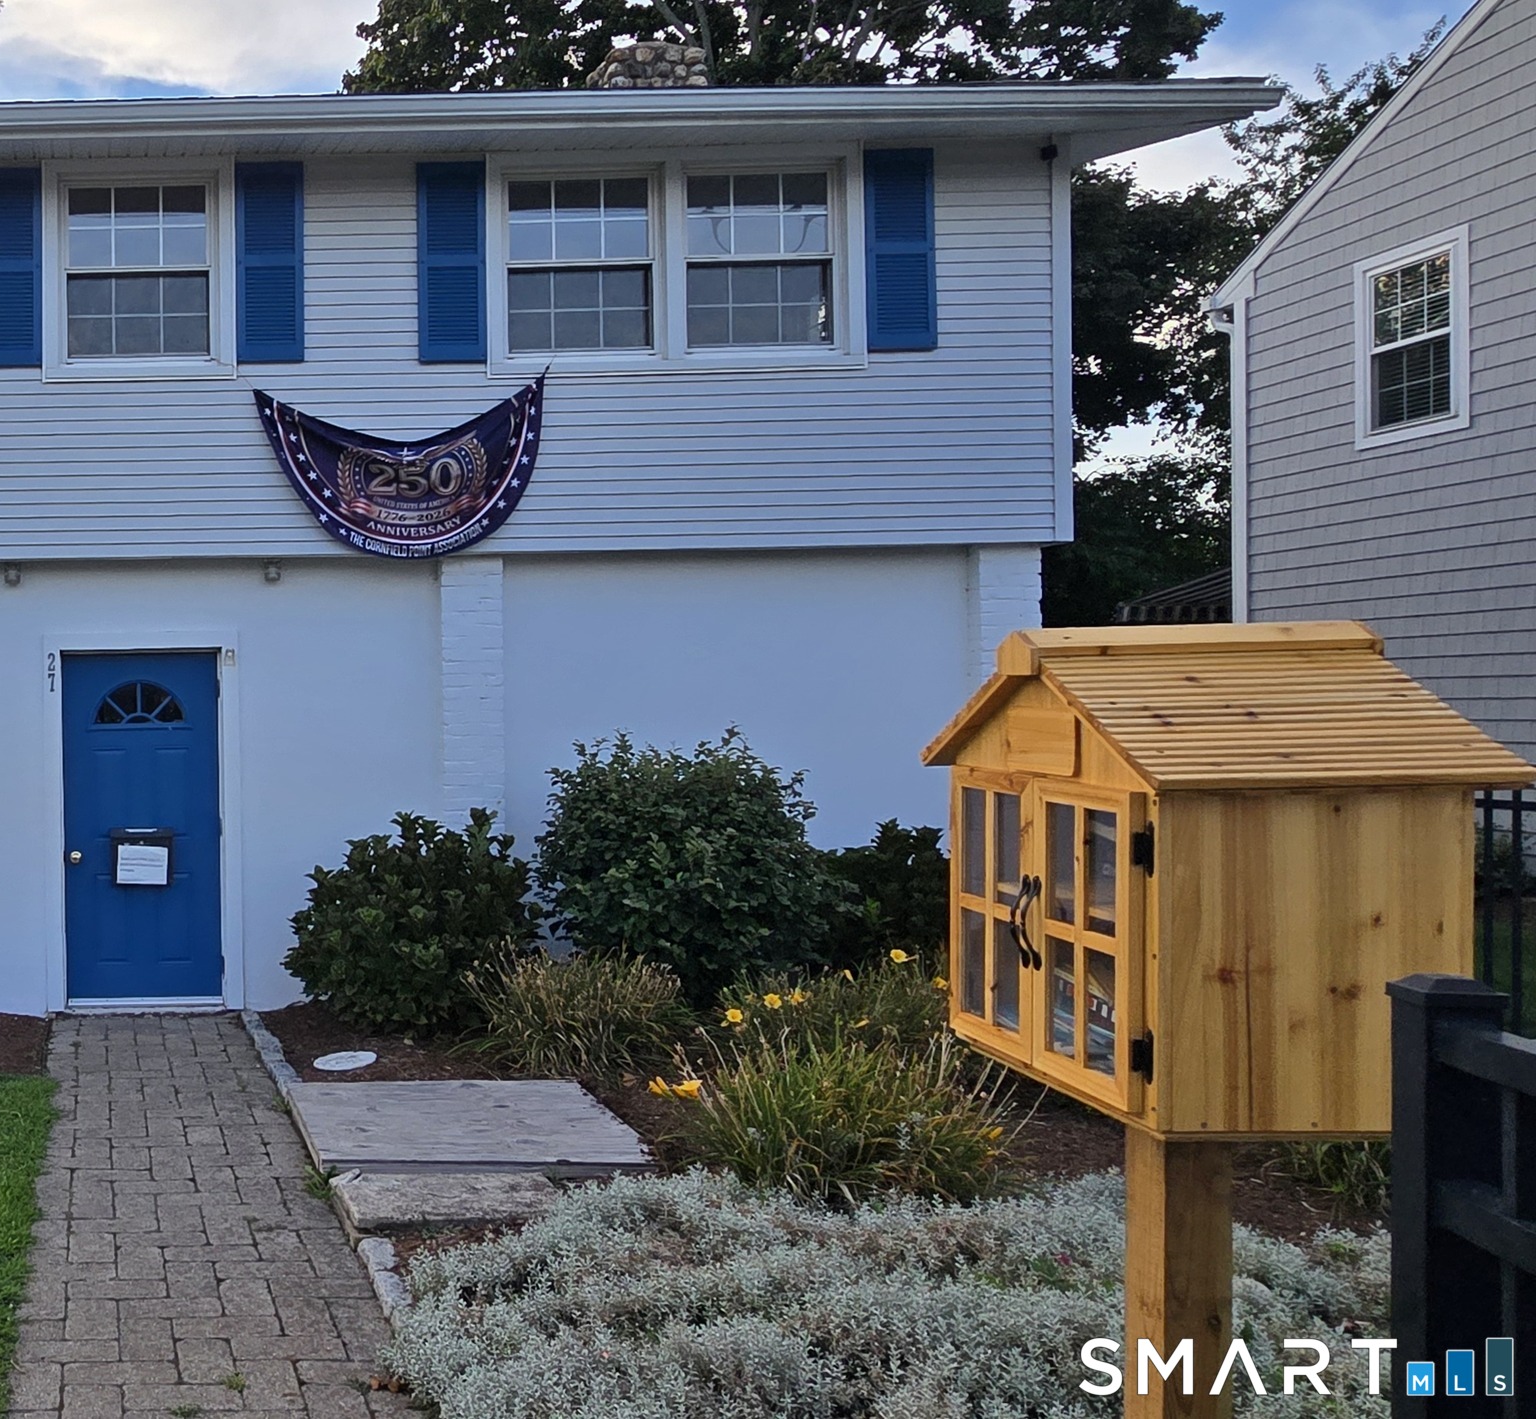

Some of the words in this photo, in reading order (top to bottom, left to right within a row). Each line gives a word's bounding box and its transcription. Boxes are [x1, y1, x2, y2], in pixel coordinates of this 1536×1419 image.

[366, 457, 462, 497] 250
[349, 531, 365, 548] THE
[365, 540, 408, 557] CORNFIELD
[409, 544, 433, 558] POINT
[433, 523, 483, 554] ASSOCIATION
[367, 515, 461, 537] ANNIVERSARY
